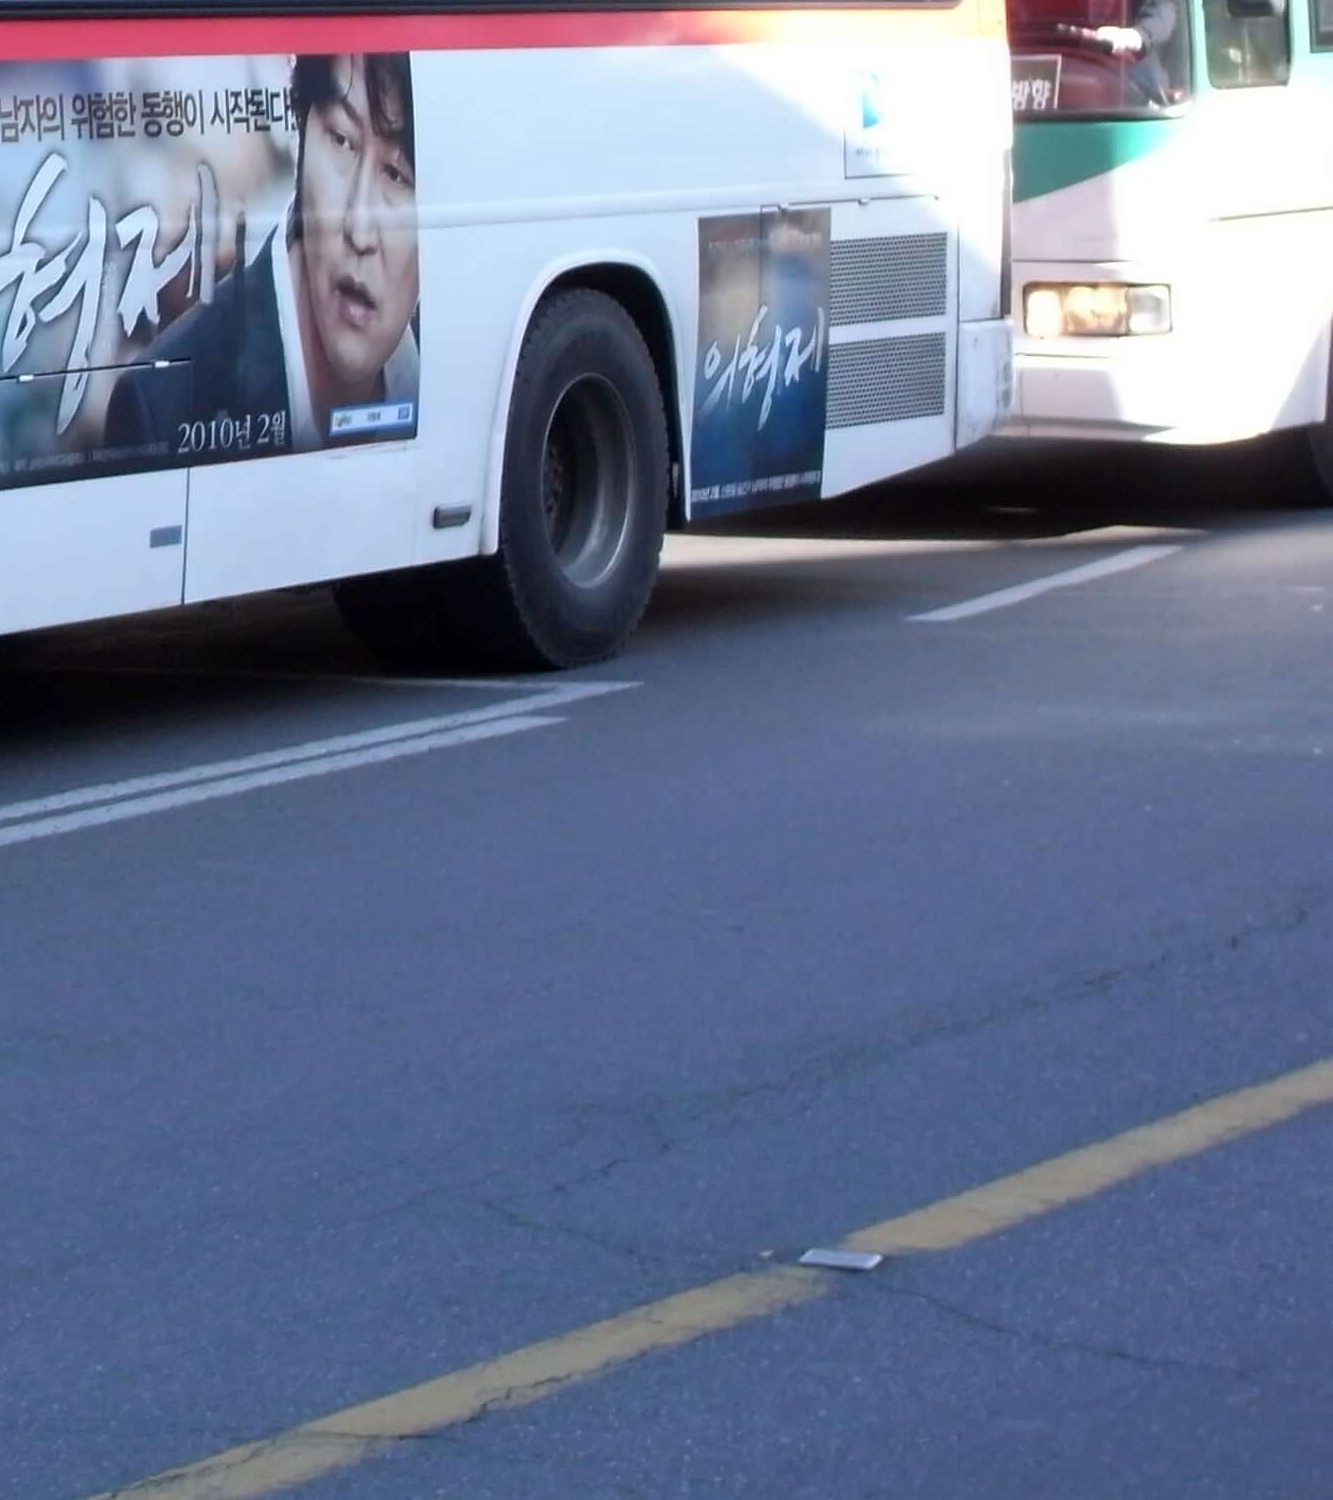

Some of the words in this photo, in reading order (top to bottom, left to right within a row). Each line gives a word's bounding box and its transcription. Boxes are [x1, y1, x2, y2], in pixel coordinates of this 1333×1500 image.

[71, 91, 137, 140] 위험한
[141, 88, 206, 138] 동행이
[699, 304, 825, 433] 의형제
[176, 414, 251, 453] 2010년
[256, 409, 287, 445] 2월
